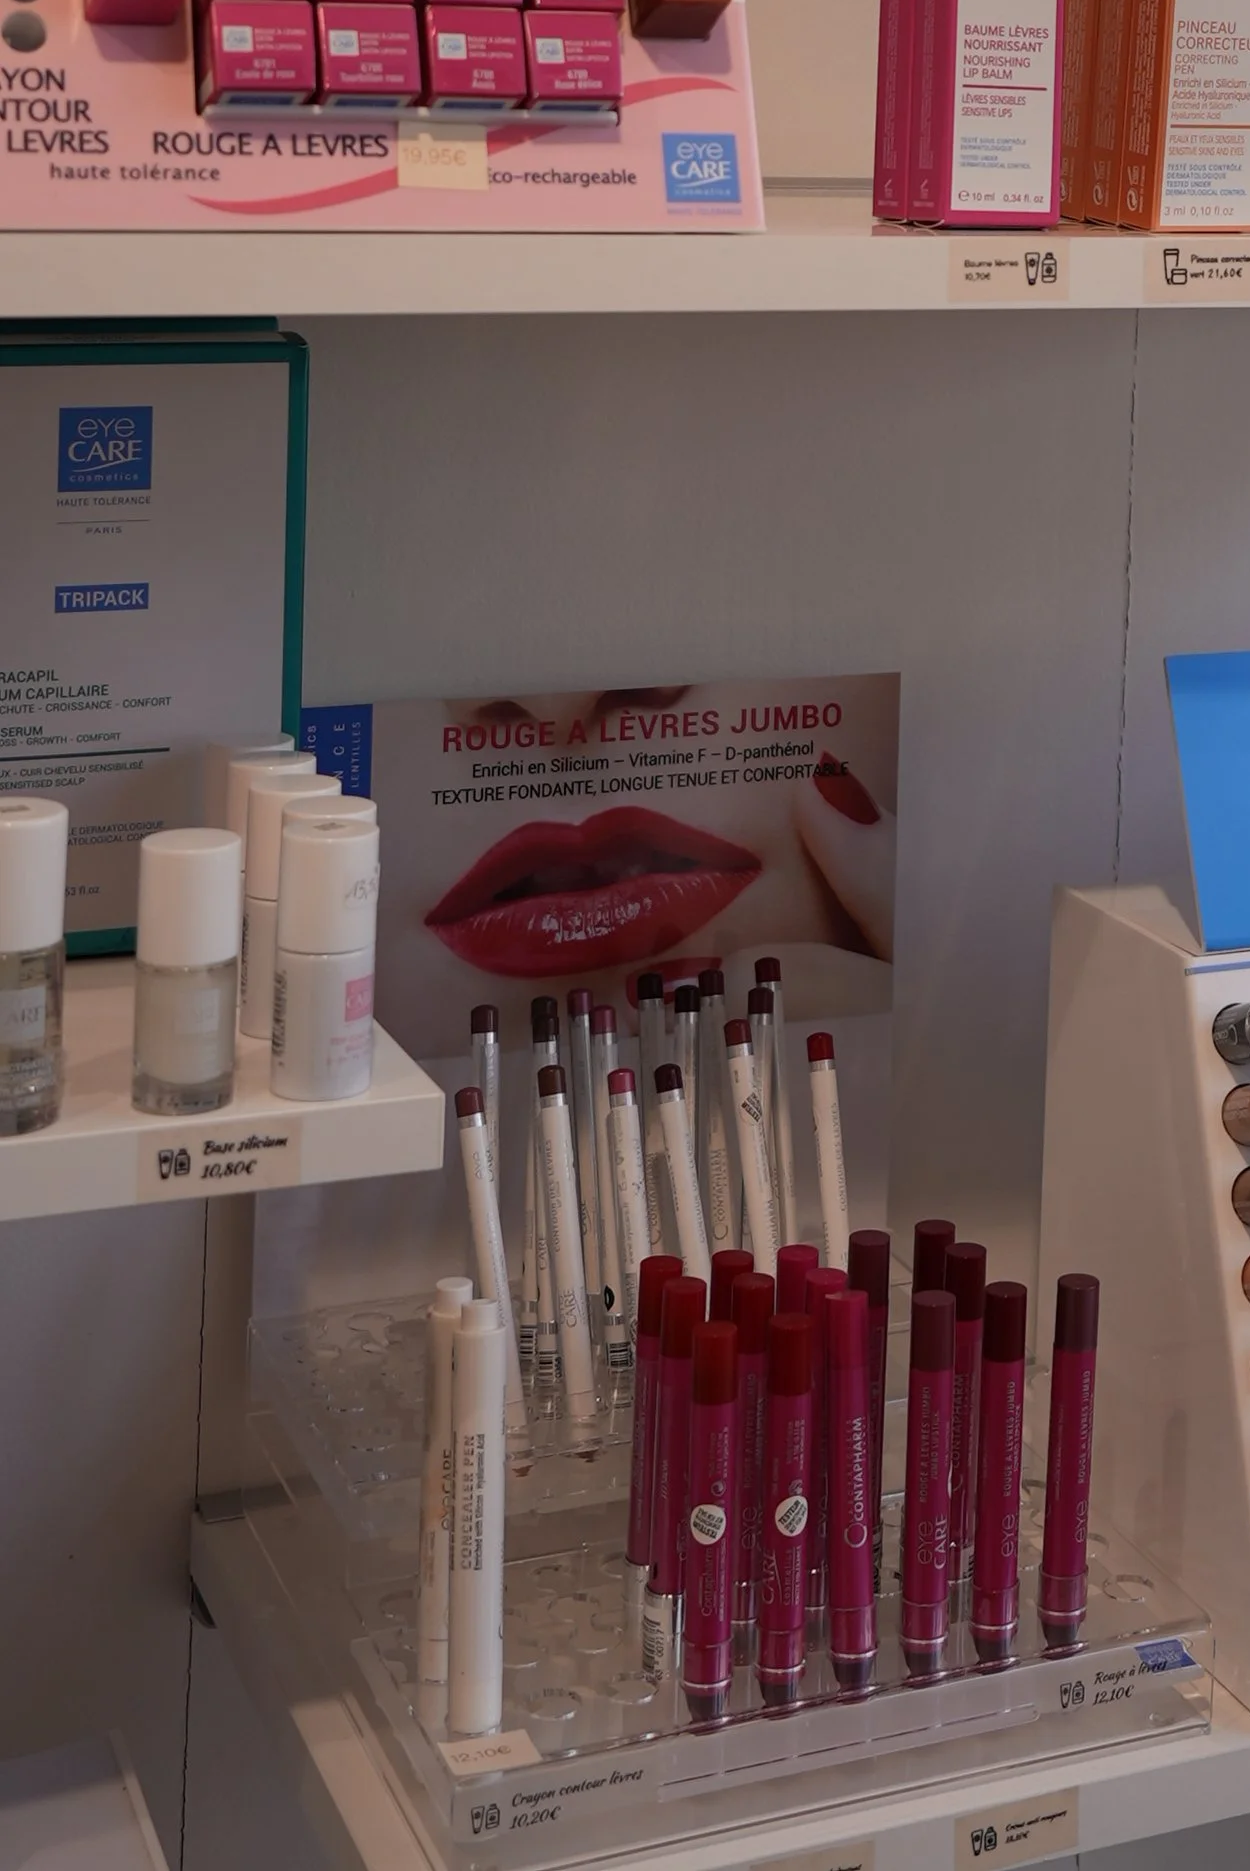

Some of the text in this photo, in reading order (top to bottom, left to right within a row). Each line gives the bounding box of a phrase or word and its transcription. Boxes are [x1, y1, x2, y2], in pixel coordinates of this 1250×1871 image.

[964, 25, 1049, 39] BAUME LÈVRES
[1177, 21, 1236, 35] PINCEAU
[964, 39, 1043, 52] NOURRISSANT
[963, 55, 1031, 68] NOURISHING
[1175, 54, 1239, 65] CORRECTING
[963, 68, 1012, 80] LIP BALM
[6, 129, 110, 155] LEVRES
[152, 130, 390, 158] ROUGE A LEVRES
[677, 142, 724, 161] eye
[402, 146, 467, 168] 19,95€
[50, 163, 221, 181] haute tolérance
[671, 161, 731, 180] CARE
[1207, 268, 1244, 279] 21,60€
[78, 418, 135, 438] eye
[68, 440, 143, 462] CARE
[59, 589, 144, 608] TRIPACK
[26, 684, 109, 700] CAPILLAIRE
[45, 696, 172, 712] CROISSANCE CONFORT
[442, 702, 843, 753] ROUGE A LÈVRES JUMBO
[472, 740, 814, 778] Enrichi Silicium Vitamine F D-panthénol
[432, 761, 849, 805] TEXTURE FONDANTE, LONGUE TENUE ET CONFORTABLE
[203, 1140, 236, 1156] Base
[200, 1160, 258, 1178] 10,80€
[853, 1416, 864, 1521] CONTAPHARM
[461, 1472, 474, 1570] CONCEALER
[1093, 1671, 1125, 1685] Rouge
[1092, 1685, 1134, 1706] 12,10€
[451, 1745, 511, 1764] 12,10€
[512, 1769, 644, 1807] Crayon contour lèvres
[509, 1806, 562, 1829] 10,20€
